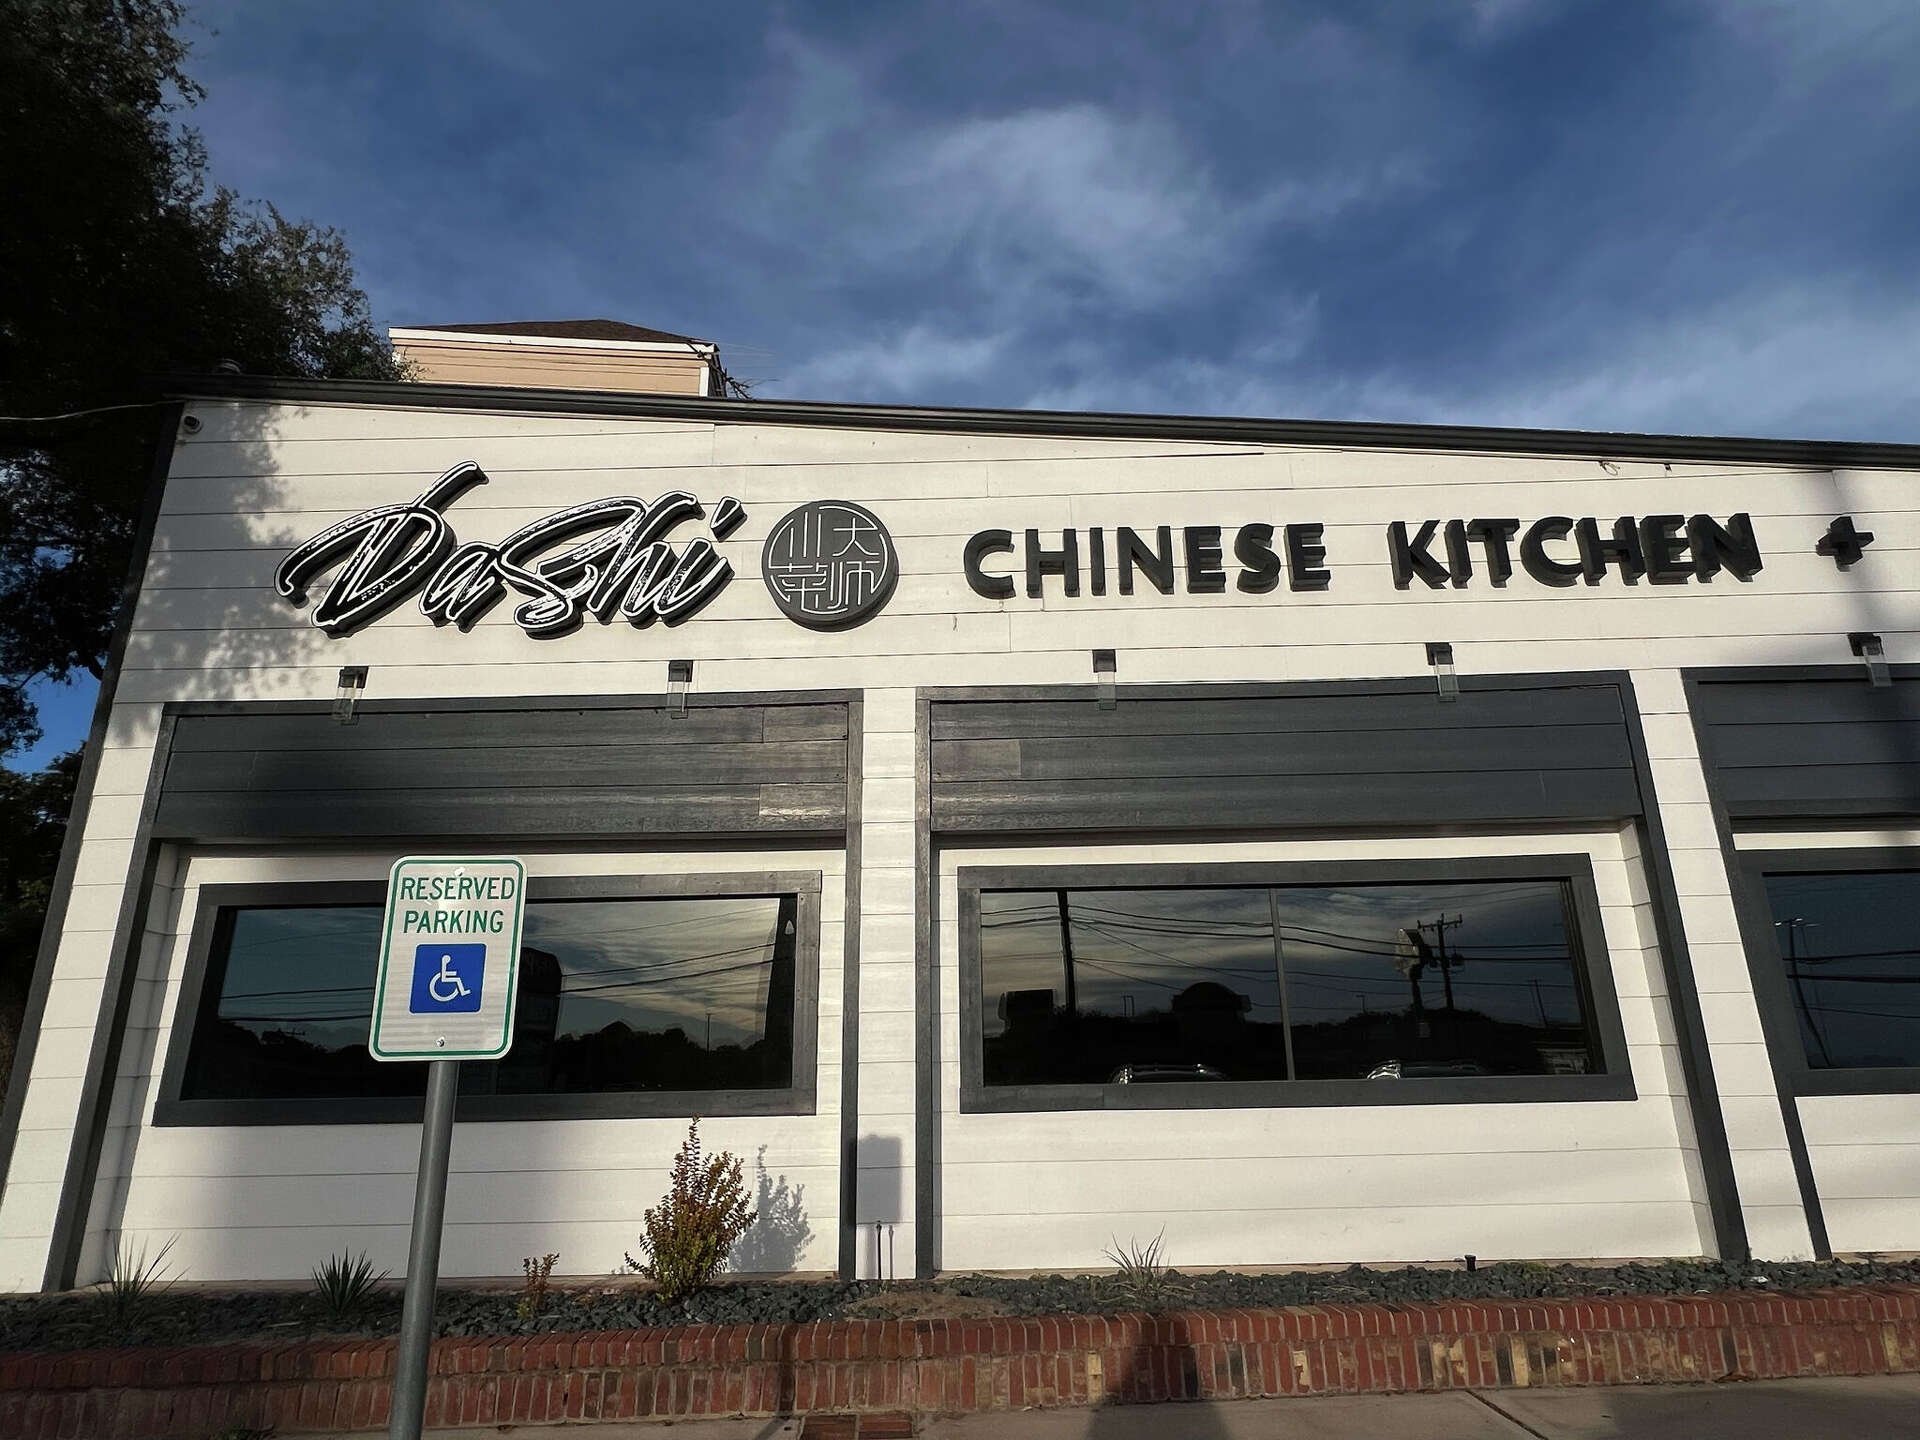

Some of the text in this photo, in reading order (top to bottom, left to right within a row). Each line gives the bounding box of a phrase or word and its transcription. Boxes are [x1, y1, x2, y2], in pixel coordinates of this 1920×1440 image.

[964, 522, 1331, 598] CHINESE
[1387, 513, 1763, 590] KITCHEN
[401, 877, 515, 900] RESERVED
[403, 910, 504, 934] PARKING
